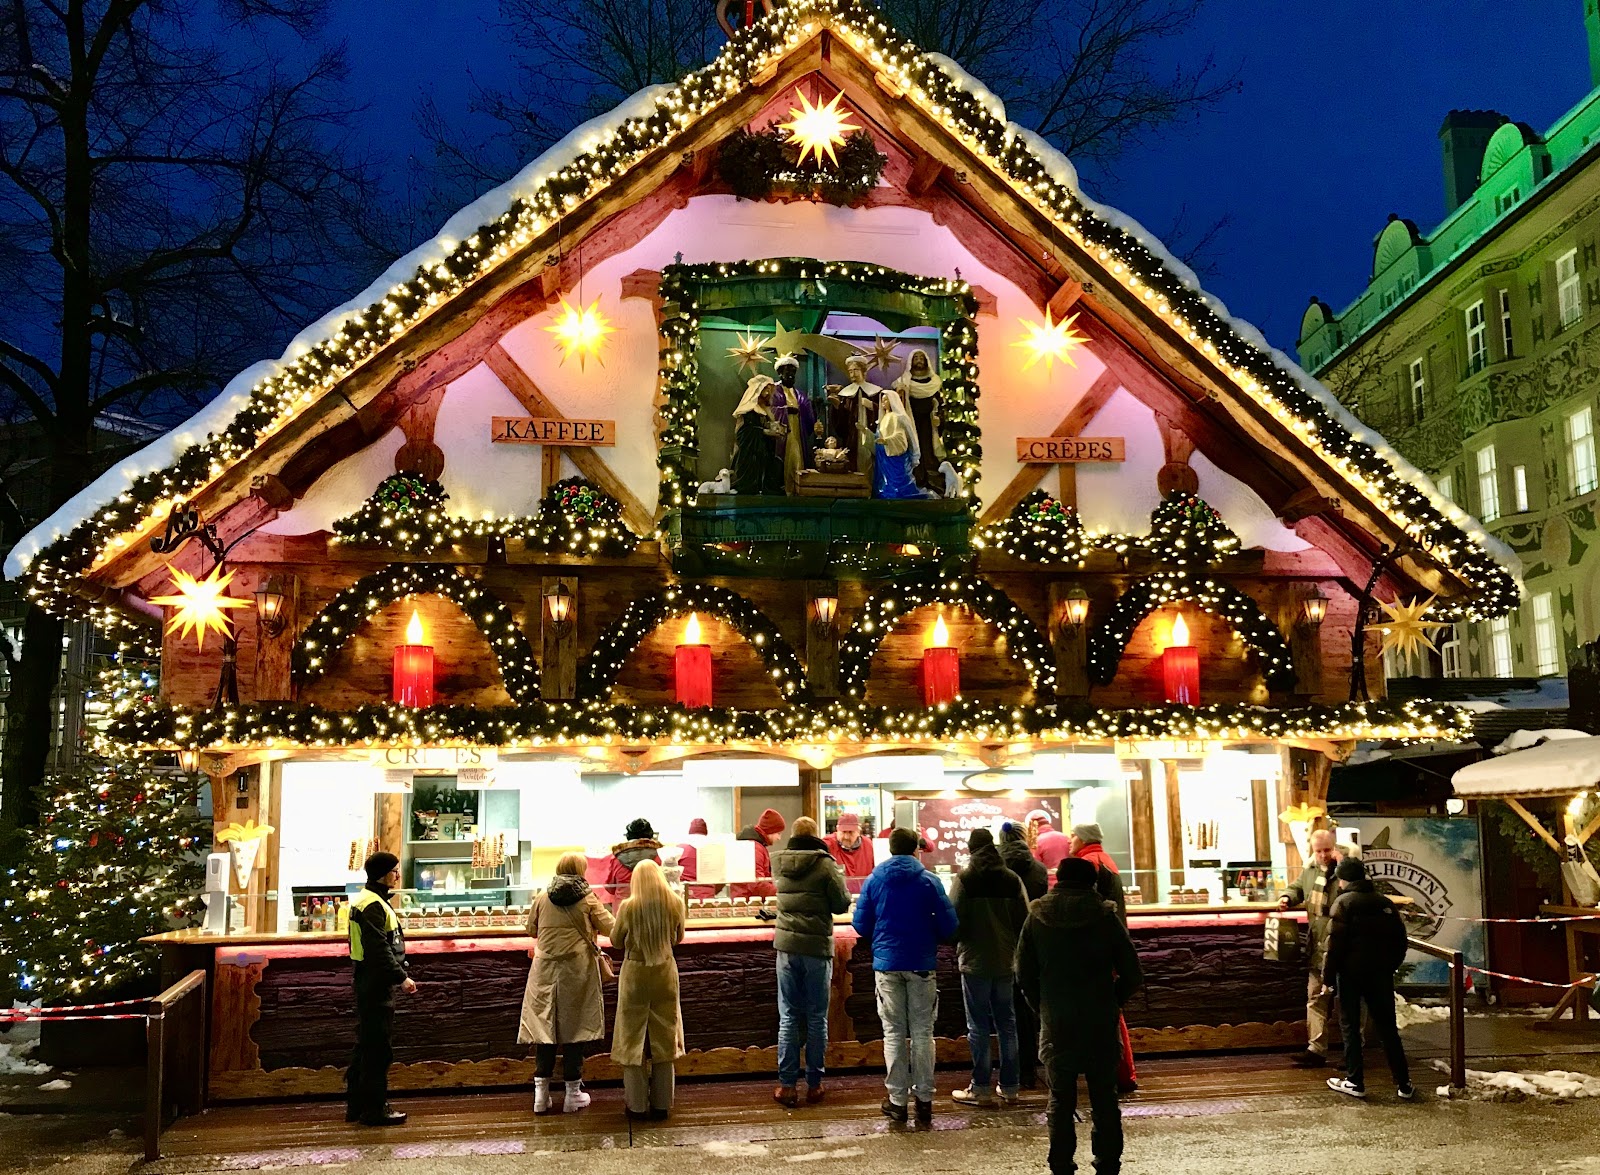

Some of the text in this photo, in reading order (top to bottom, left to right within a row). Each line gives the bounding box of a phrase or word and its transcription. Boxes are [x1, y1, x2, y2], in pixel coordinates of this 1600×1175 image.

[505, 420, 604, 441] KAFFEE
[1030, 438, 1112, 459] CRÊPES
[385, 748, 481, 764] CRES
[1264, 918, 1279, 951] 225
